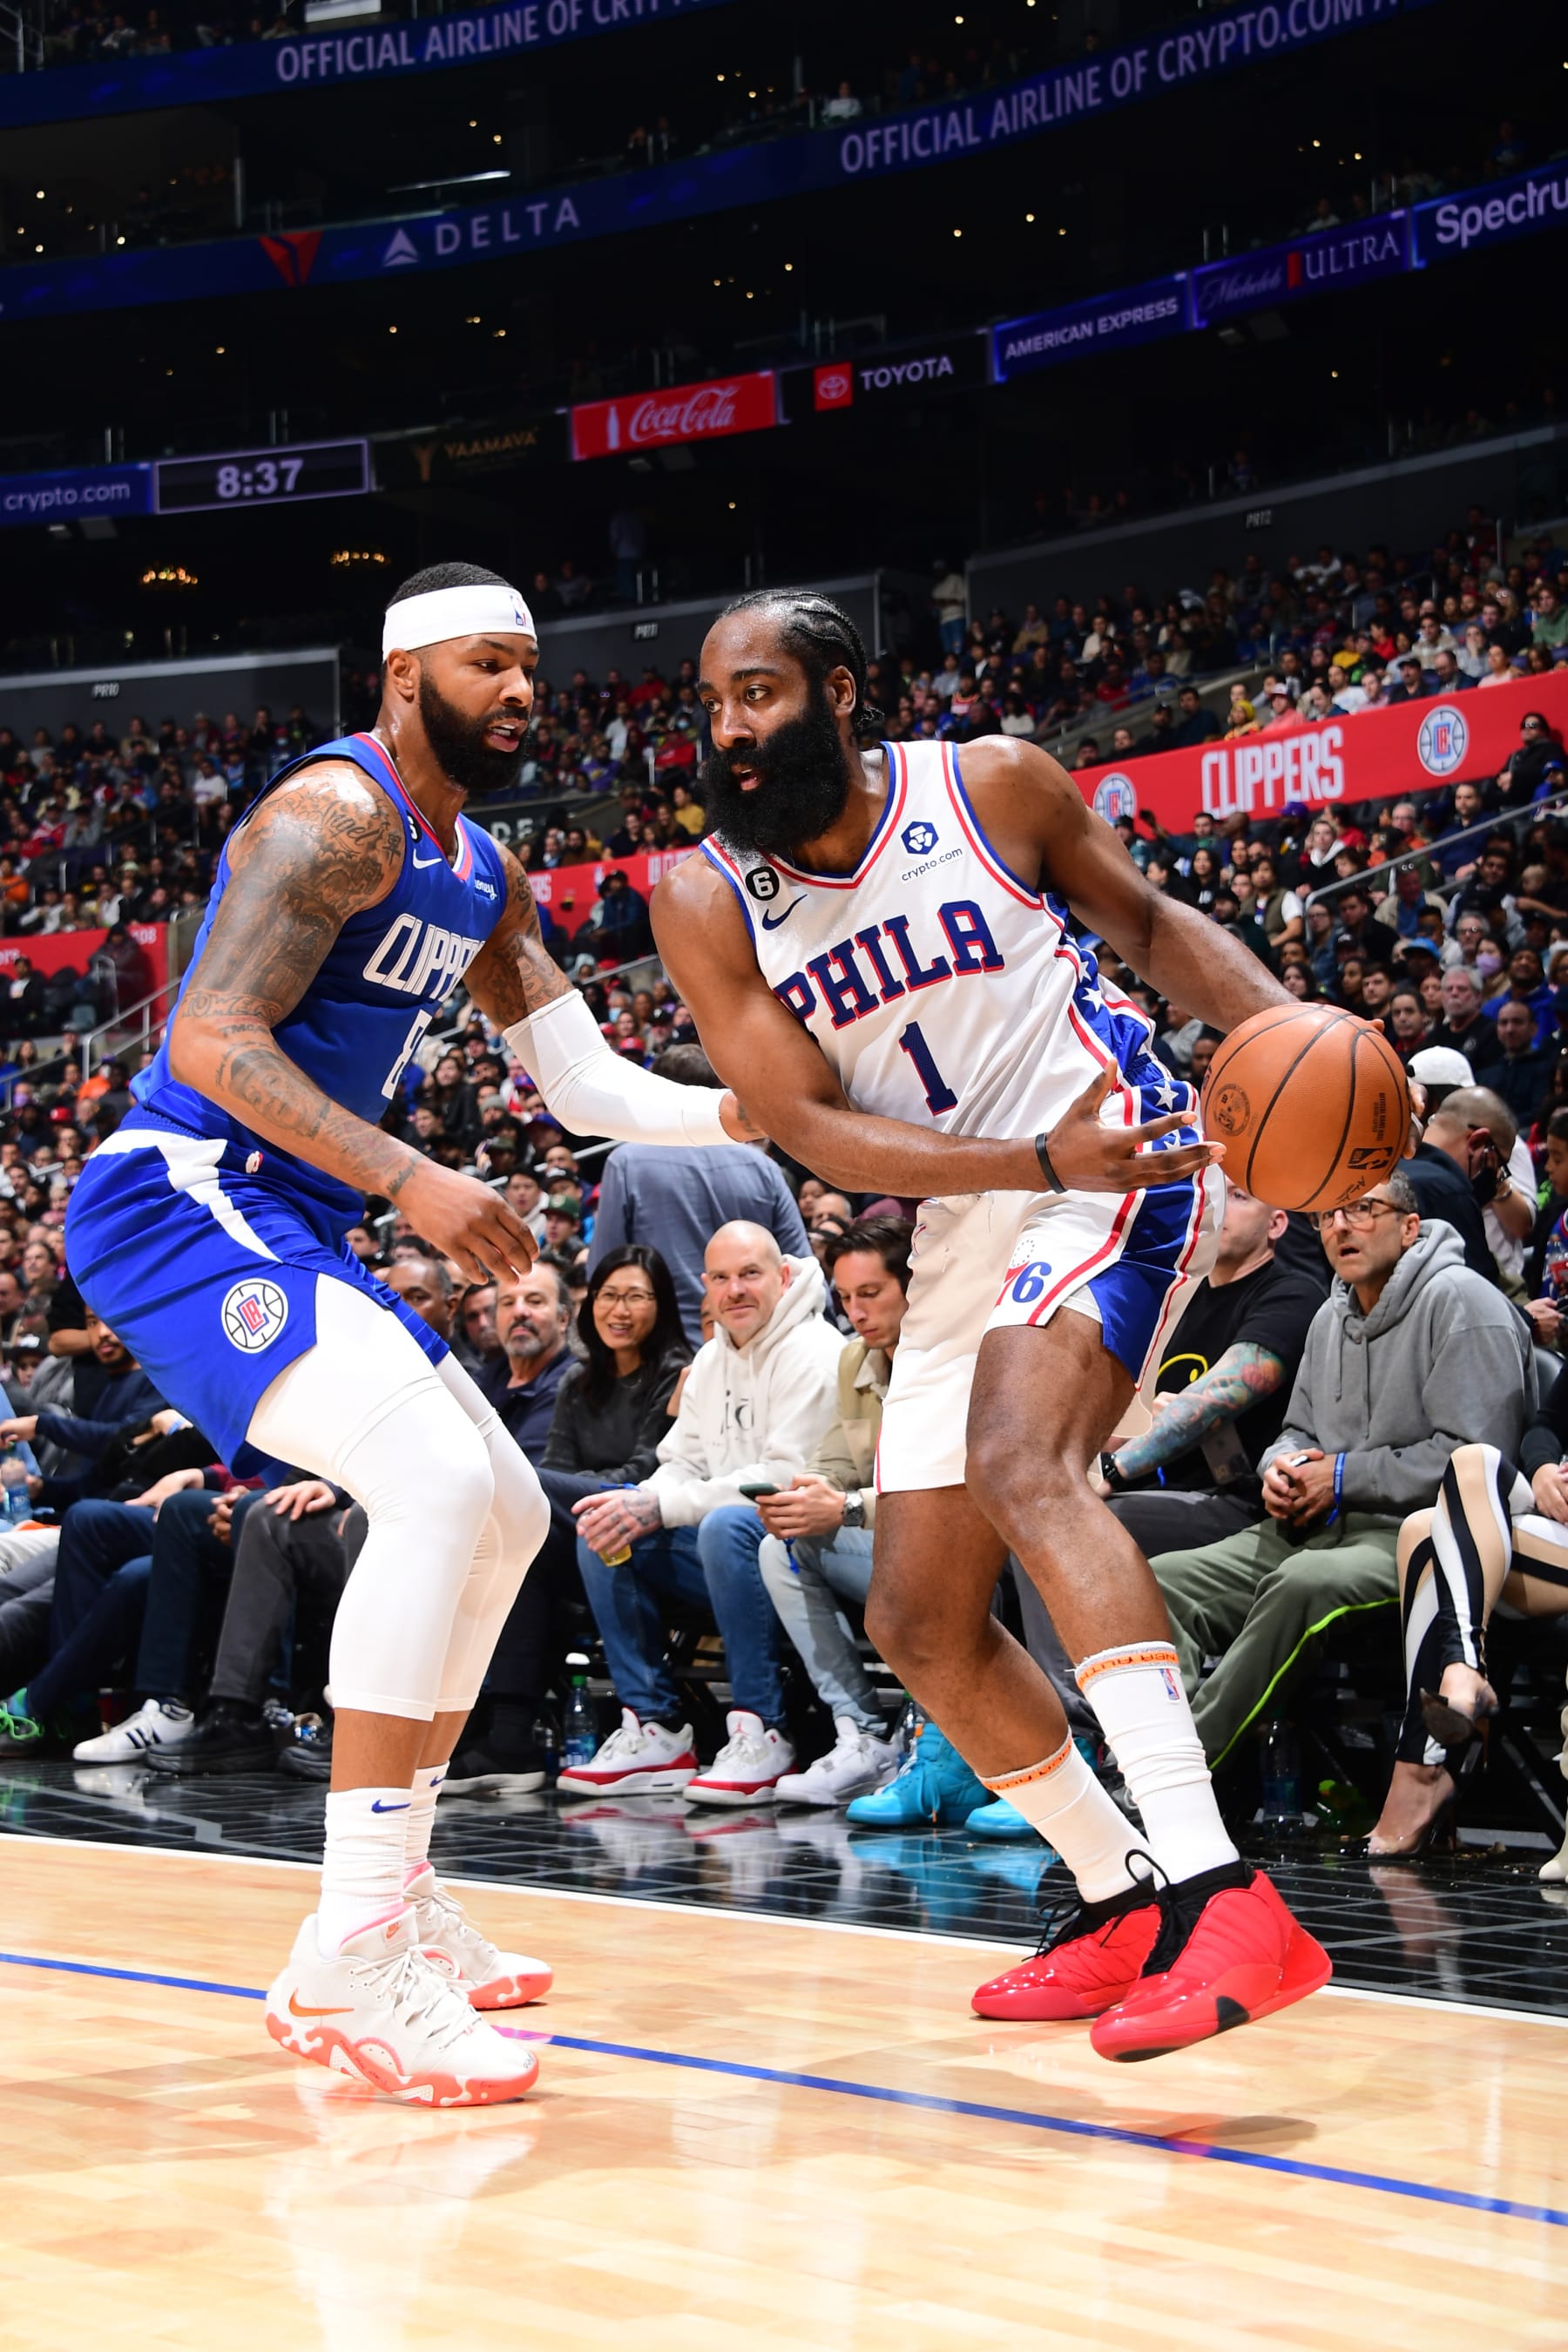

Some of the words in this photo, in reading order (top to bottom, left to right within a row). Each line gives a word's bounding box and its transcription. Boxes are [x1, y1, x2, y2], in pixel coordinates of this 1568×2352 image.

[275, 29, 416, 83] OFFICIAL
[423, 9, 538, 63] AIRLINE
[546, 0, 584, 37] OF
[841, 111, 982, 174] OFFICIAL
[989, 65, 1103, 141] AIRLINE
[1110, 49, 1149, 98] OF
[1158, 0, 1364, 83] CRYPTO.COM
[436, 197, 581, 256] DELTA
[1304, 230, 1401, 280] ULTRA
[1004, 321, 1094, 362] AMERICAN
[1097, 297, 1179, 334] EXPRESS
[860, 354, 956, 391] TOYOTA
[3, 480, 131, 513] crypto.com
[216, 457, 305, 500] 8:37
[1201, 725, 1344, 821] CLIPPERS
[753, 871, 774, 897] 6
[902, 848, 963, 882] crypto.com
[773, 900, 1005, 1031] PHILA
[898, 1020, 958, 1116] 1
